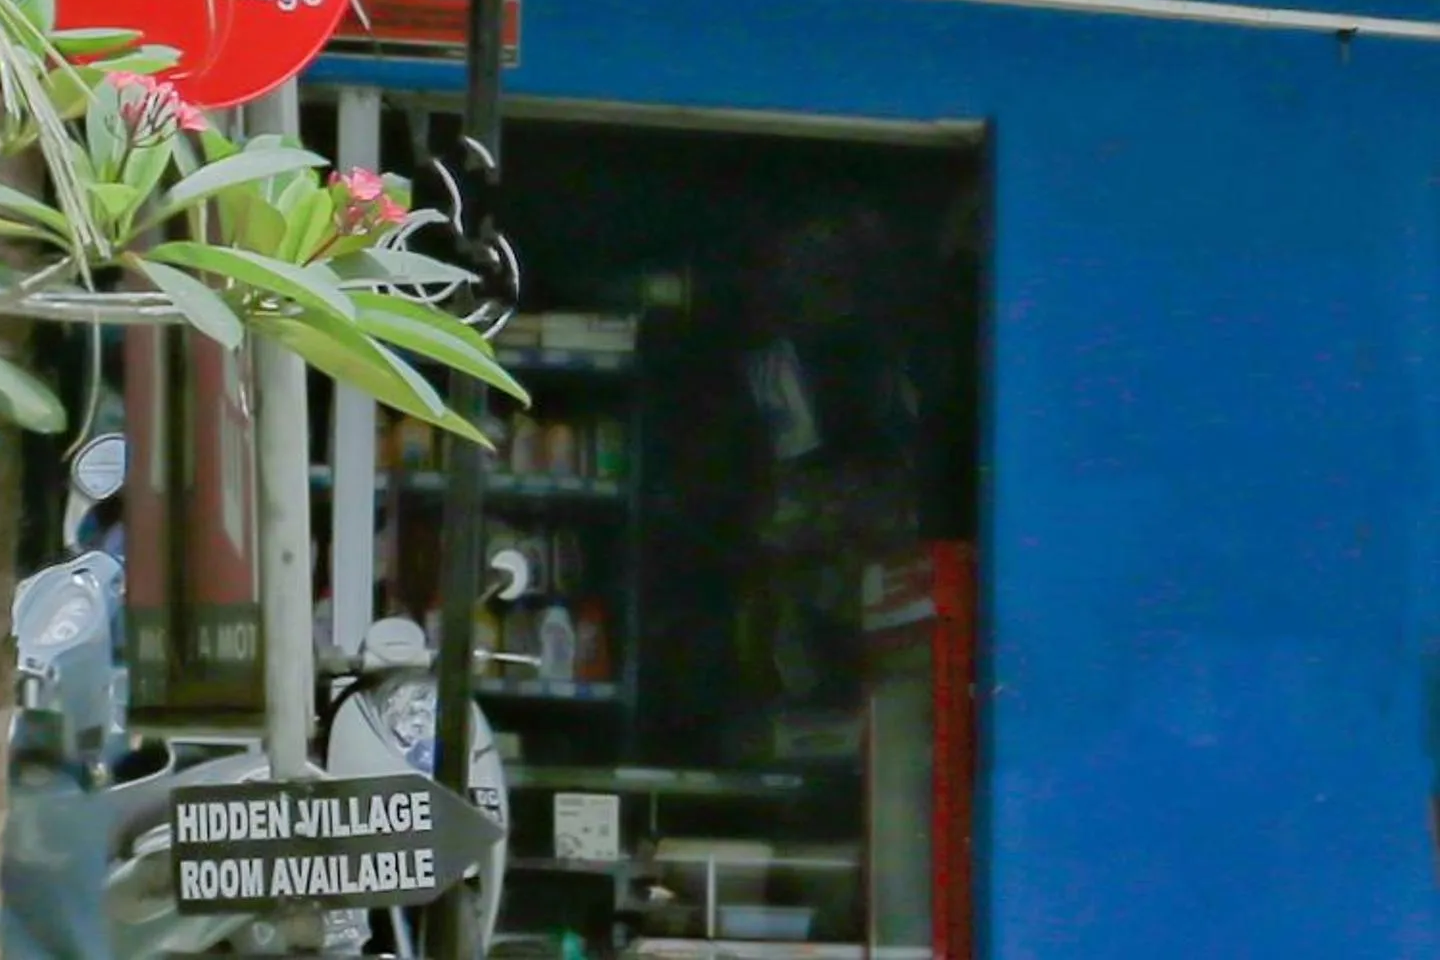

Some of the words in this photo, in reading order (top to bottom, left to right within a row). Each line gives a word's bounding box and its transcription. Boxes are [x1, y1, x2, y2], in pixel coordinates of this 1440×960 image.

[176, 799, 292, 843] HIDDEN
[297, 791, 434, 840] VILLAGE
[179, 858, 265, 900] ROOM
[270, 848, 436, 897] AVAILABLE
